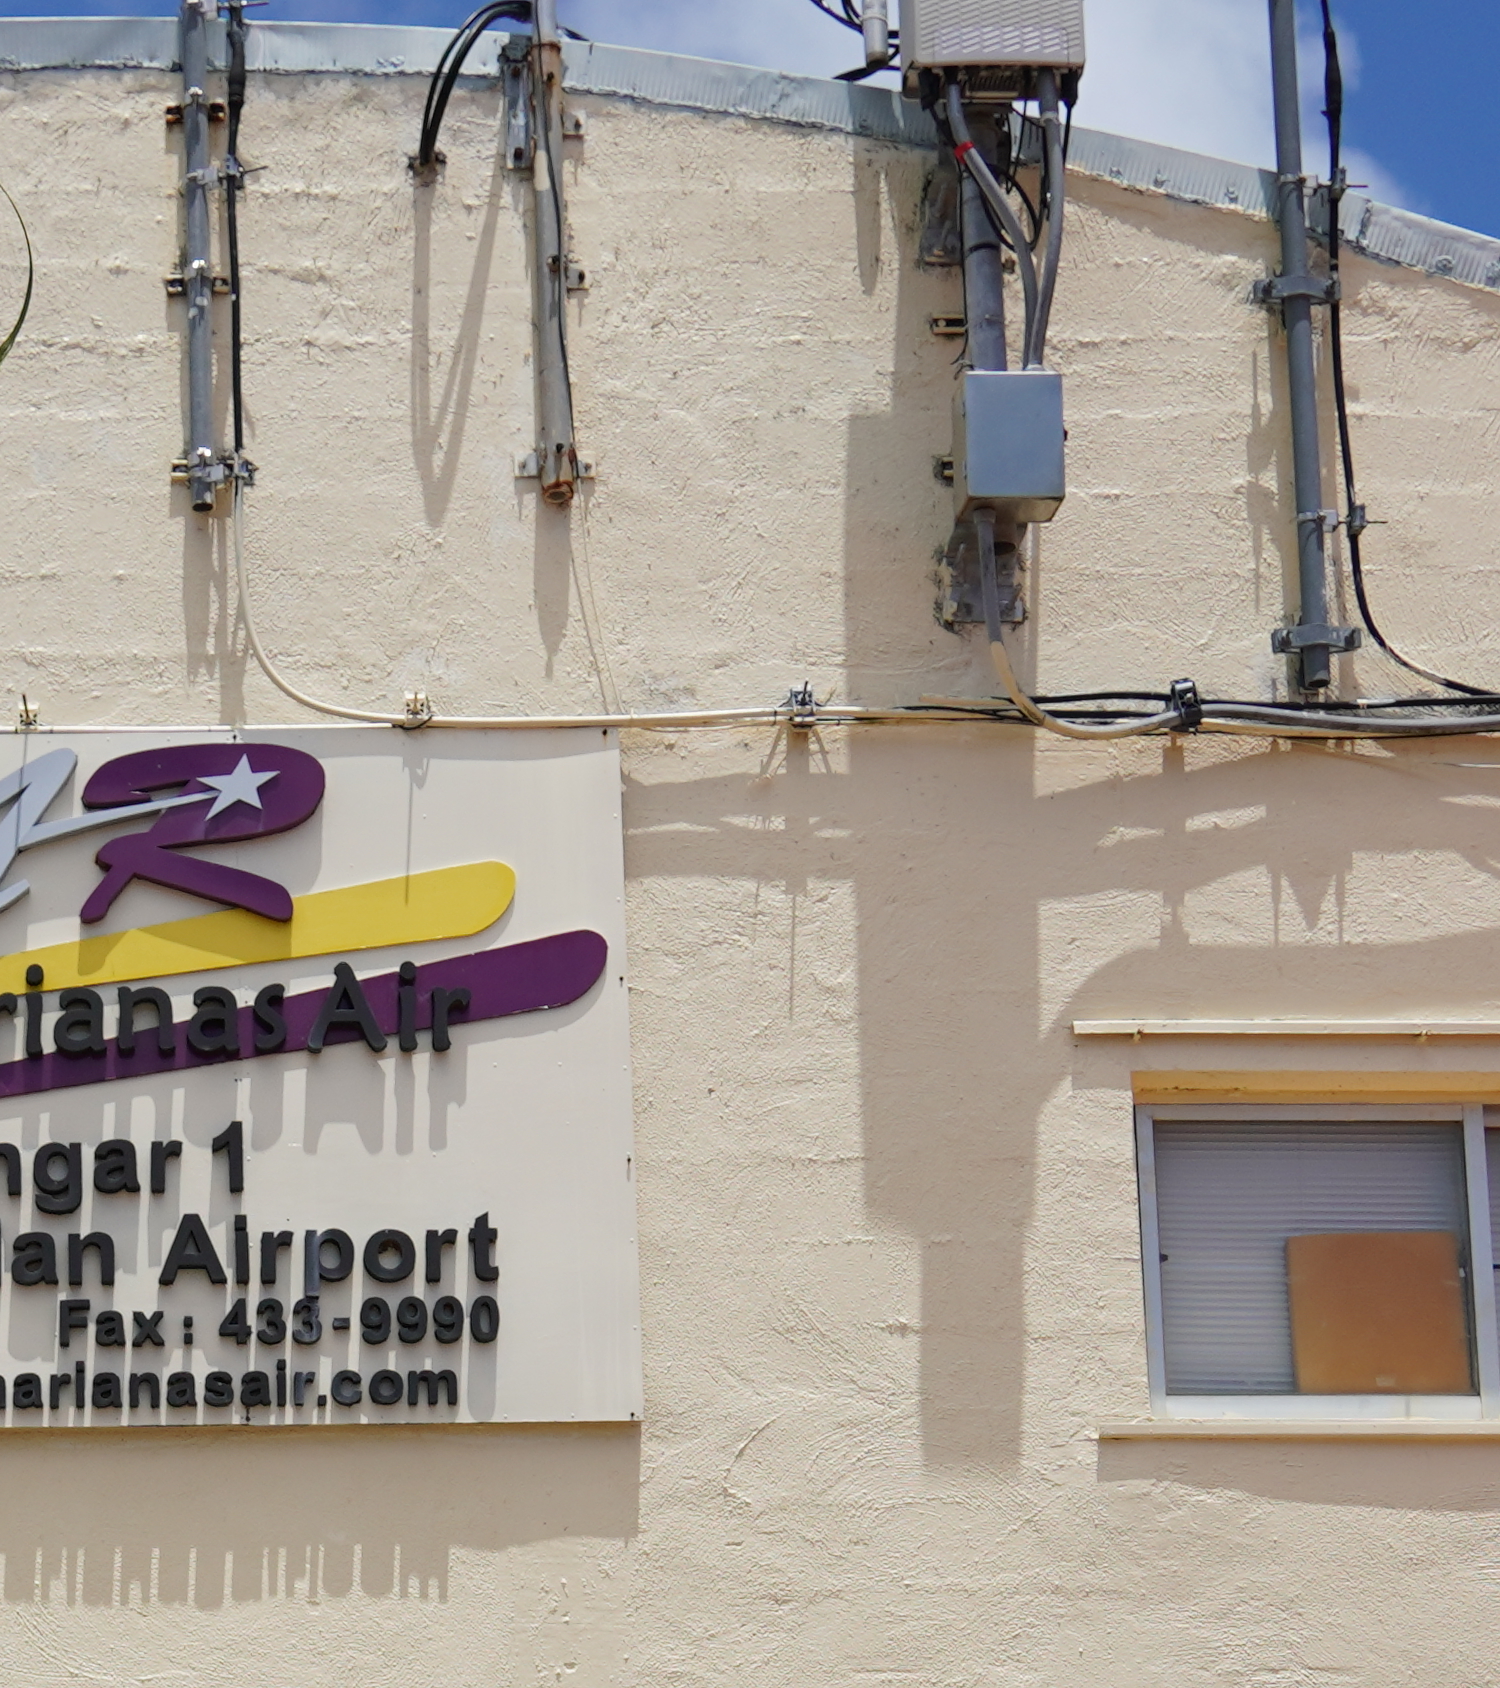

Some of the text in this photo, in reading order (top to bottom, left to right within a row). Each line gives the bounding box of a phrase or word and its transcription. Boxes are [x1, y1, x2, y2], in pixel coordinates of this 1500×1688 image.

[307, 961, 471, 1054] Air
[212, 1121, 245, 1195] 1
[159, 1212, 499, 1299] Airport
